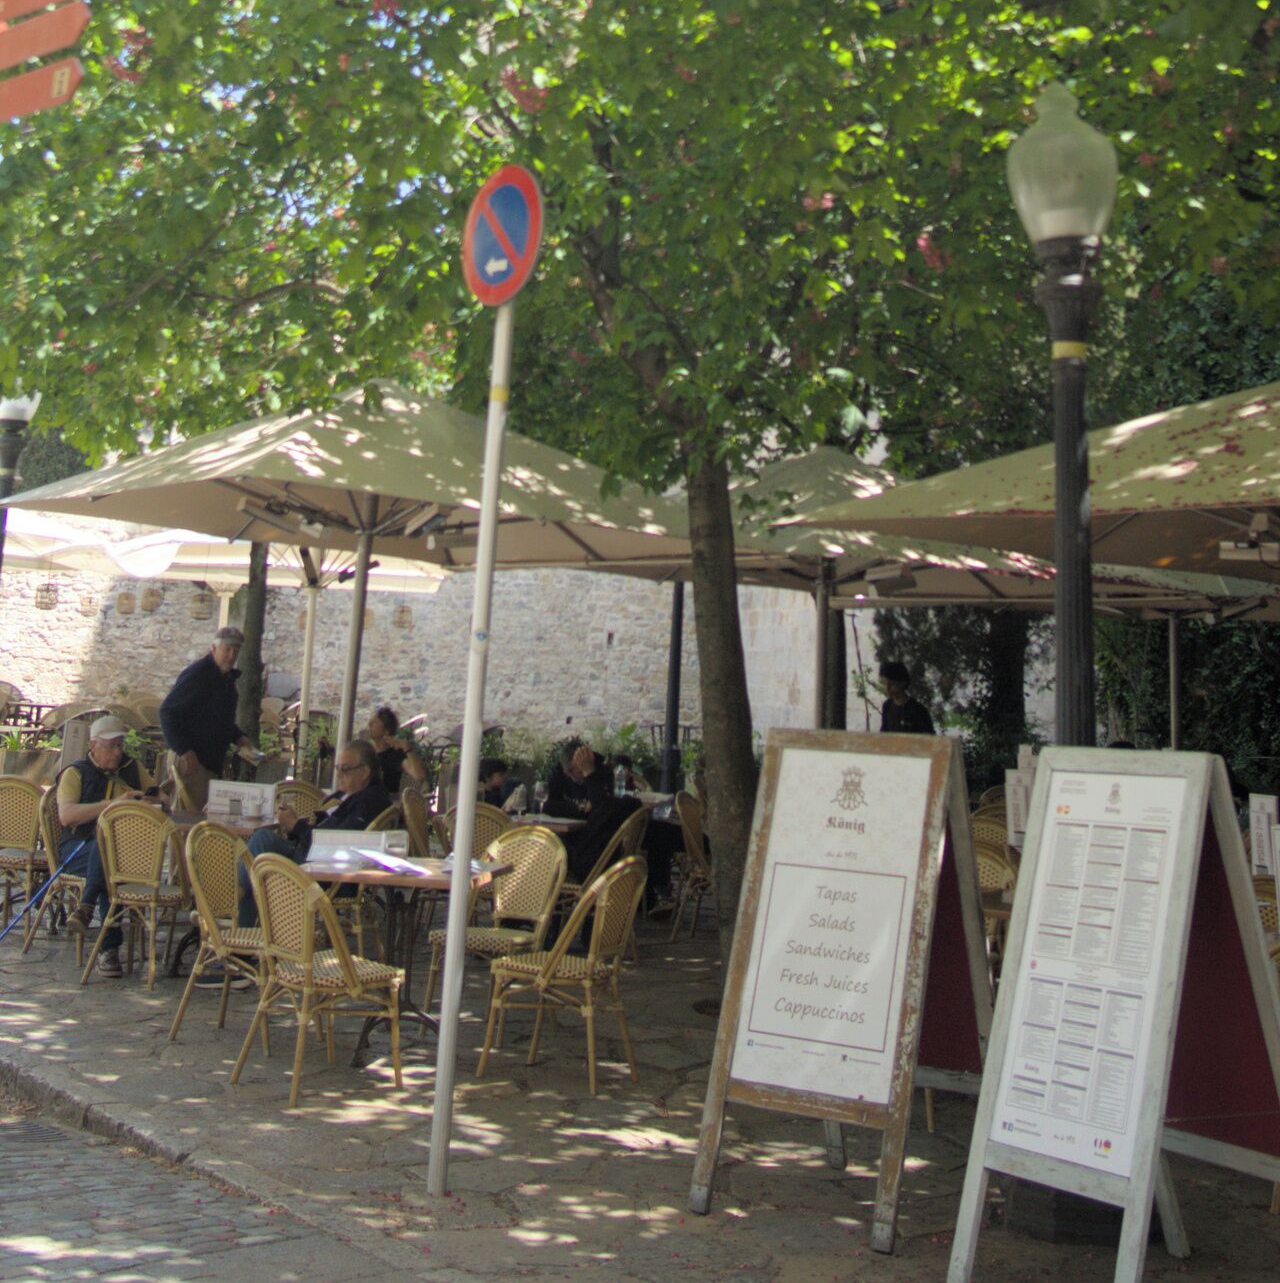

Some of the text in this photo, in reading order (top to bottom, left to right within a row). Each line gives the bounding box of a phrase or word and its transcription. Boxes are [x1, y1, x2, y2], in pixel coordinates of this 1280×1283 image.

[826, 815, 866, 835] König
[816, 885, 858, 905] Tapas
[808, 913, 856, 933] Salads
[785, 939, 871, 964] Sandwiches
[779, 967, 869, 995] Fresh Juices
[774, 996, 866, 1024] Cappuccinos
